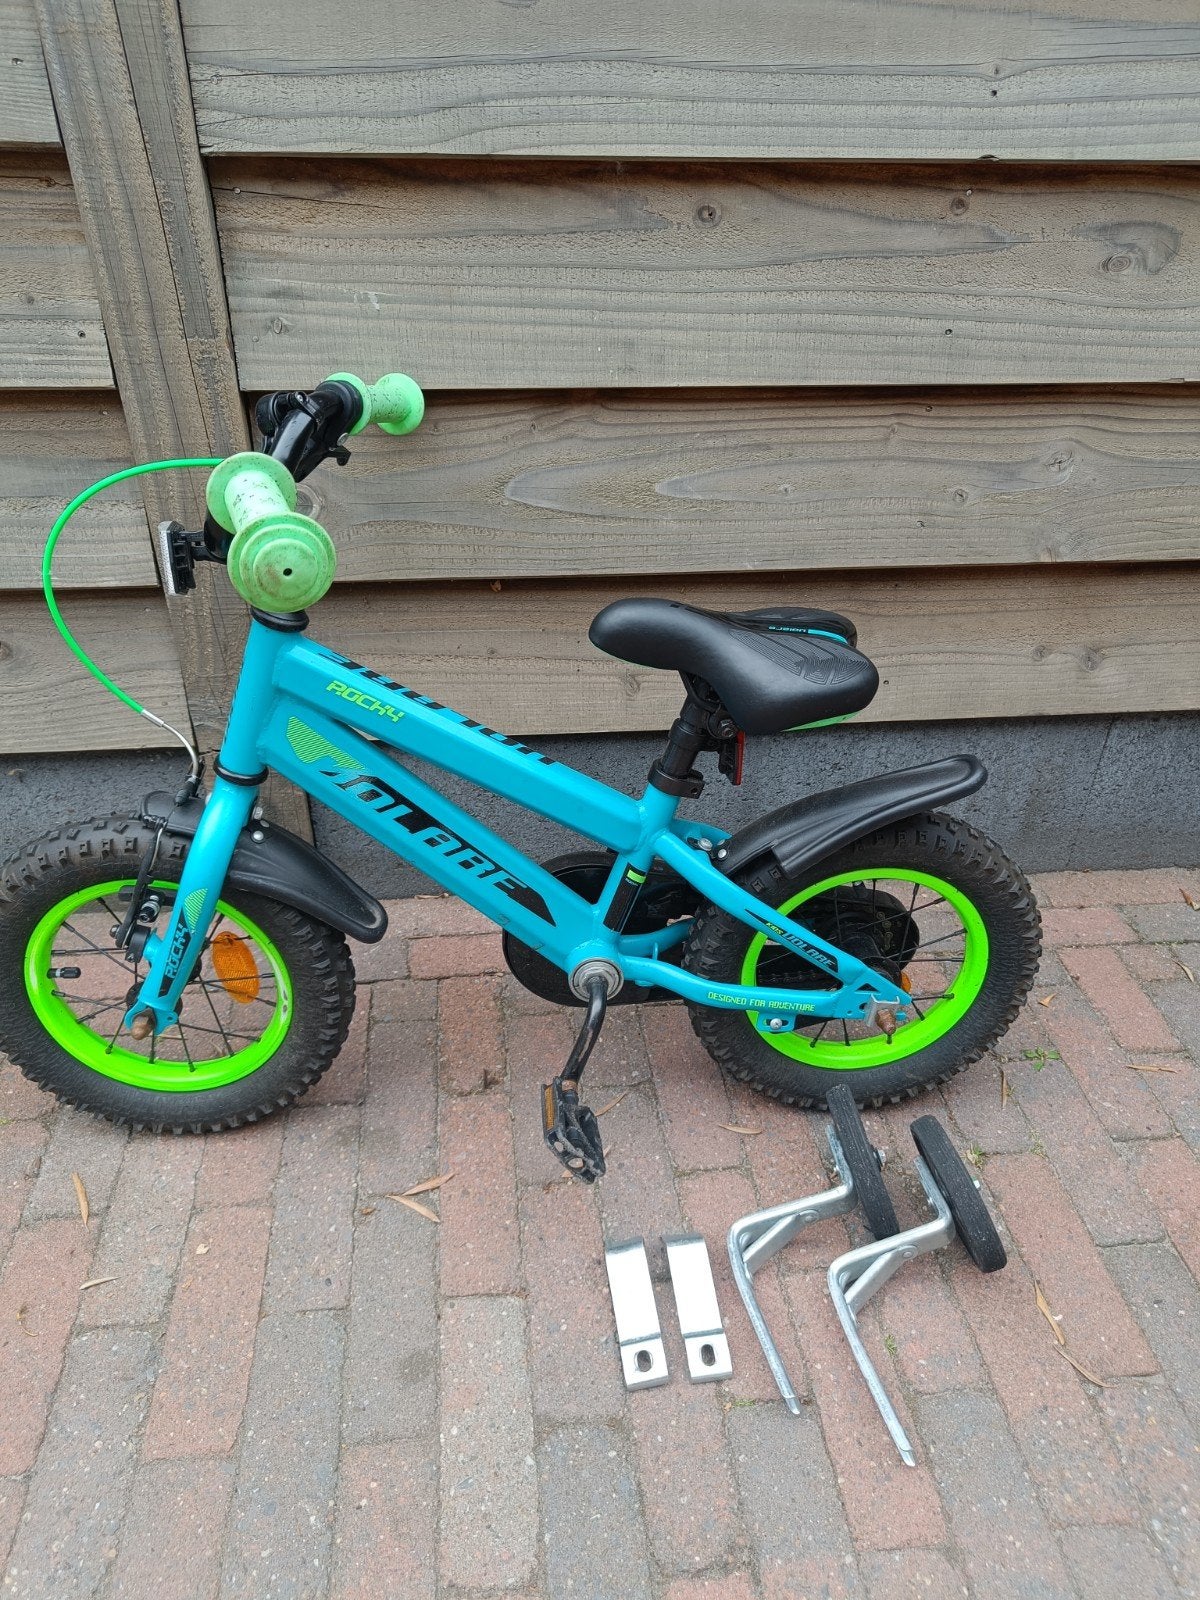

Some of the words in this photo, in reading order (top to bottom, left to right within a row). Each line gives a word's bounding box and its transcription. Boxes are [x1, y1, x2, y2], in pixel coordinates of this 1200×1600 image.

[326, 680, 405, 723] ROCKY
[165, 923, 189, 979] ROCKY
[708, 991, 747, 1006] DESIGNED
[750, 998, 766, 1008] FOR
[768, 1000, 816, 1012] ADVENTURE
